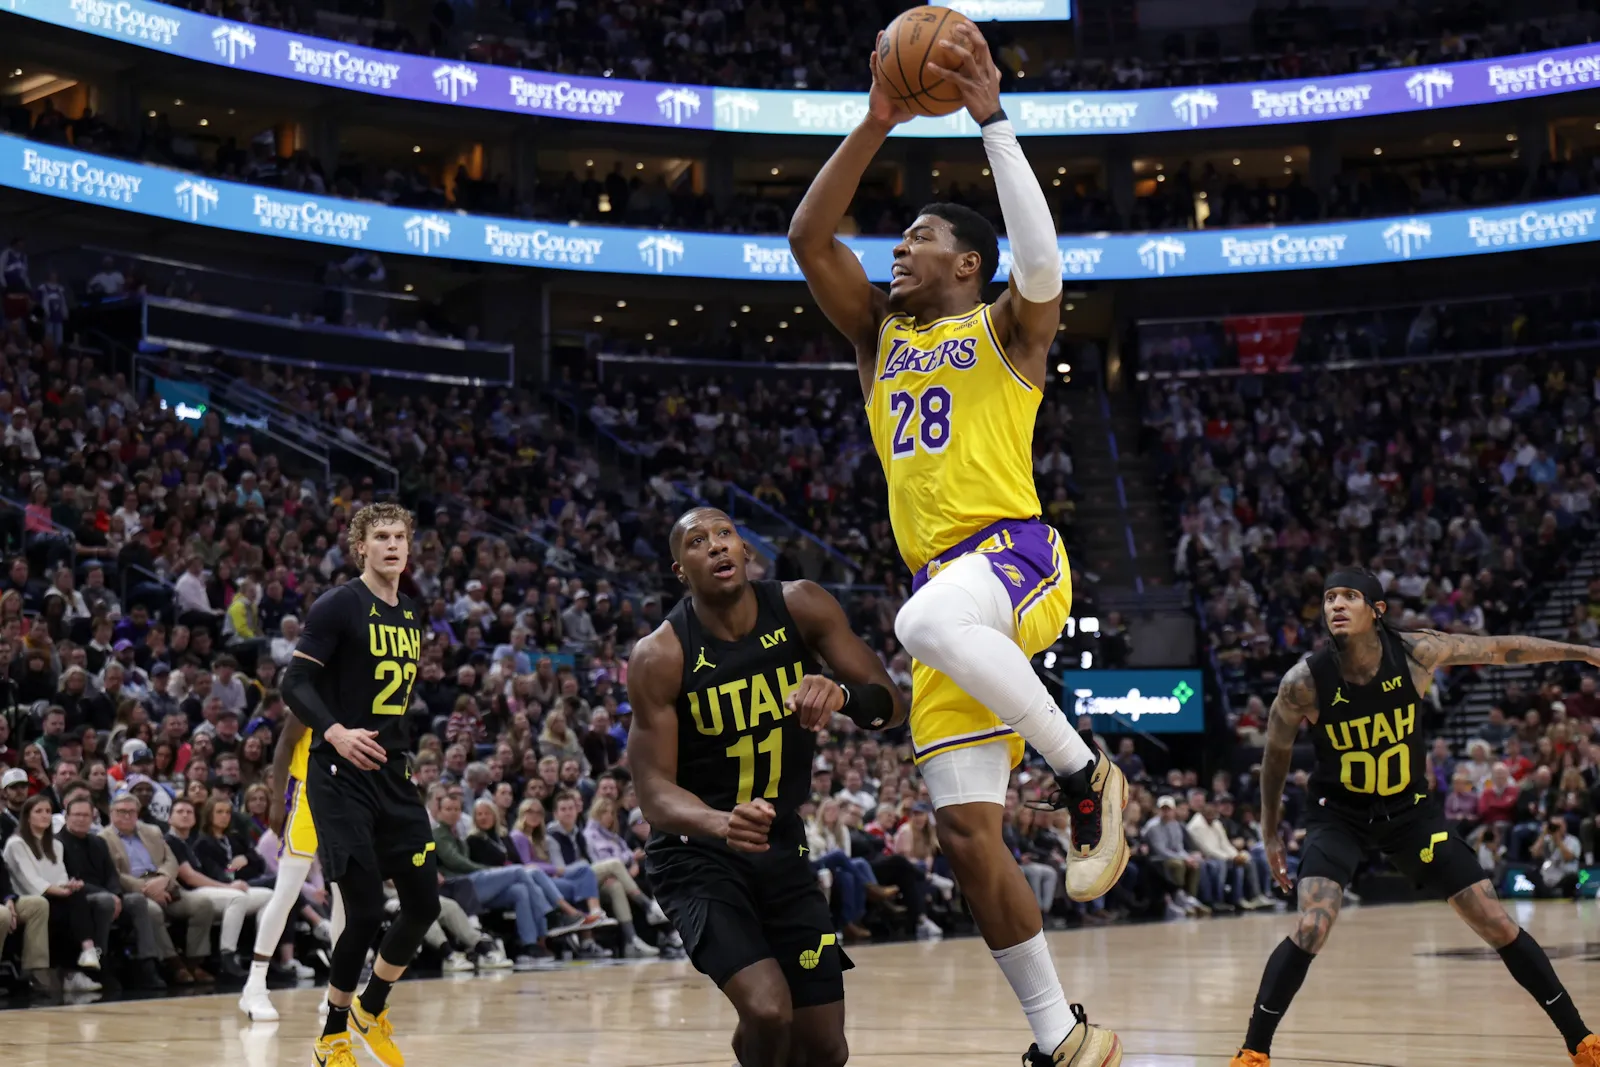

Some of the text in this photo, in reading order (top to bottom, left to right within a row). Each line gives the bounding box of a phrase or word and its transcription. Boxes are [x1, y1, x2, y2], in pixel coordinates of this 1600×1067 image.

[294, 61, 391, 89] MORTGAGE
[515, 95, 615, 115] MORTGAGE
[1259, 100, 1364, 117] MORTGAGE
[29, 171, 133, 203] MORTGAGE
[260, 215, 362, 240] MORTGAGE
[1475, 223, 1588, 247] MORTGAGE
[491, 244, 595, 265] MORTGAGE
[1228, 250, 1339, 267] MORTGAGE
[879, 337, 979, 381] LAKERS
[889, 385, 953, 461] 28
[368, 623, 420, 661] UTAH
[759, 627, 788, 649] LVT
[686, 660, 804, 736] UTAH
[1381, 675, 1402, 693] LVT
[1324, 702, 1416, 751] UTAH
[726, 727, 783, 804] 11
[1340, 742, 1411, 797] 00
